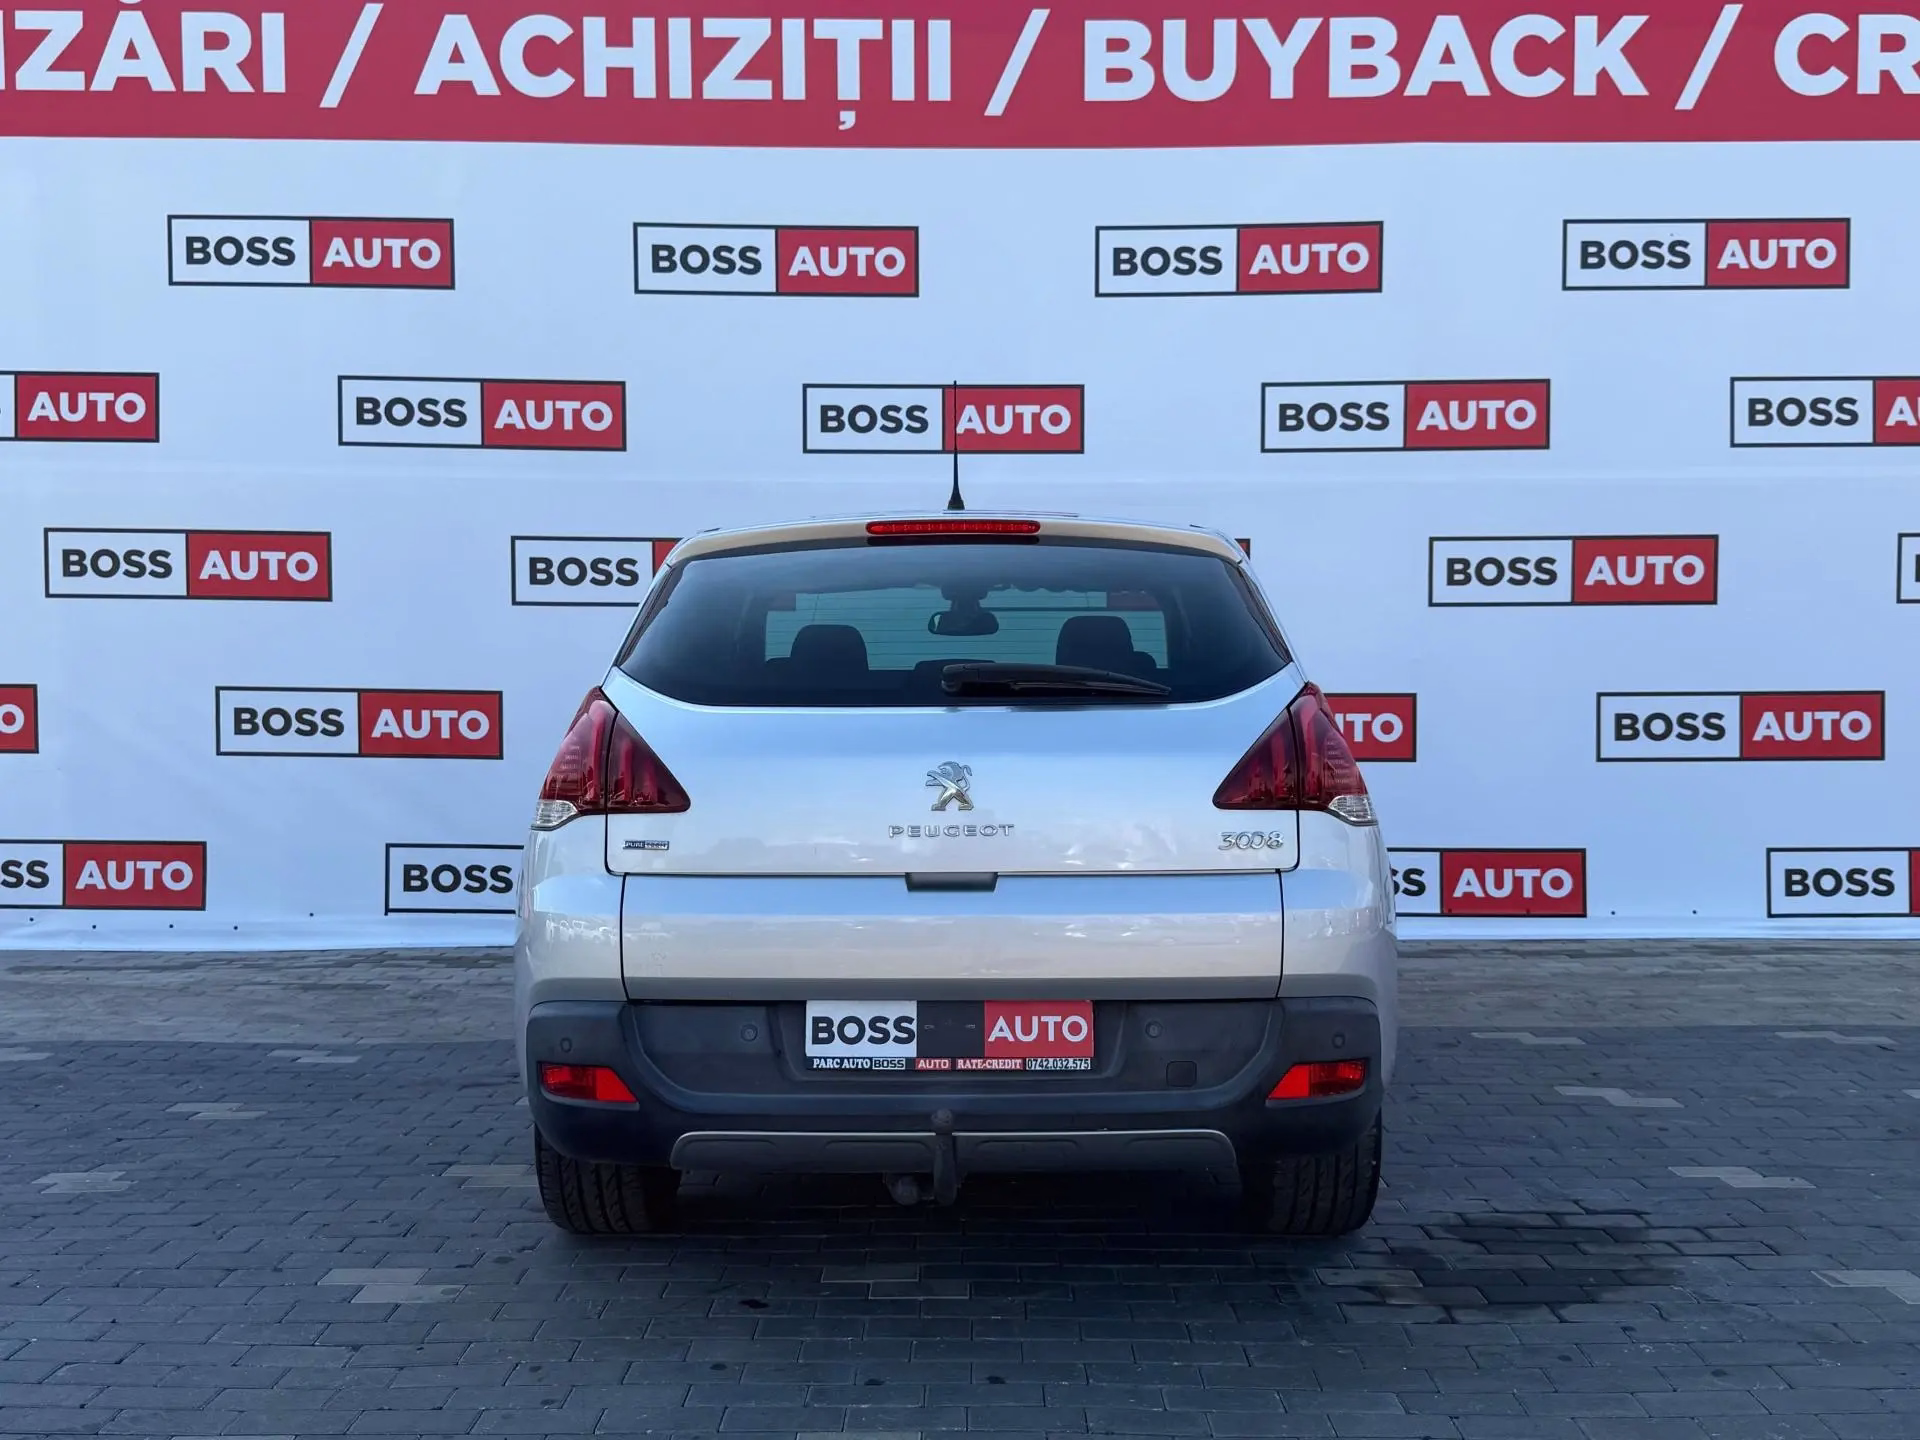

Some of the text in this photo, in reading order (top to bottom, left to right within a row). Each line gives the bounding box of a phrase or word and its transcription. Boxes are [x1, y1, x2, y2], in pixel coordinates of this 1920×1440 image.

[0, 0, 286, 93] ZĂRI
[413, 13, 952, 131] ACHIZIȚII
[1083, 13, 1650, 102] BUYBACK
[185, 236, 441, 270] BOSS AUTO
[651, 244, 906, 278] BOSS AUTO
[1112, 242, 1370, 276] BOSS AUTO
[1580, 238, 1837, 270] BOSS AUTO
[27, 391, 146, 423] AUTO
[355, 396, 613, 432] BOSS AUTO
[820, 404, 1072, 435] BOSS AUTO
[1278, 399, 1537, 432] BOSS AUTO
[1748, 397, 1859, 427] BOSS
[62, 548, 319, 582] BOSS AUTO
[528, 556, 640, 587] BOSS
[1446, 554, 1705, 587] BOSS AUTO
[233, 707, 490, 740] BOSS AUTO
[1614, 710, 1872, 742] BOSS AUTO
[888, 823, 1015, 839] PEUGEOT
[1218, 830, 1284, 850] 3008
[75, 860, 193, 891] AUTO
[402, 863, 514, 894] BOSS
[1453, 868, 1573, 898] AUTO
[1784, 867, 1896, 898] BOSS
[811, 1015, 1088, 1046] BOSS AUTO
[813, 1058, 840, 1069] PARC
[841, 1058, 871, 1069] AUTO
[873, 1058, 905, 1070] BOSS
[918, 1060, 949, 1069] AUTO
